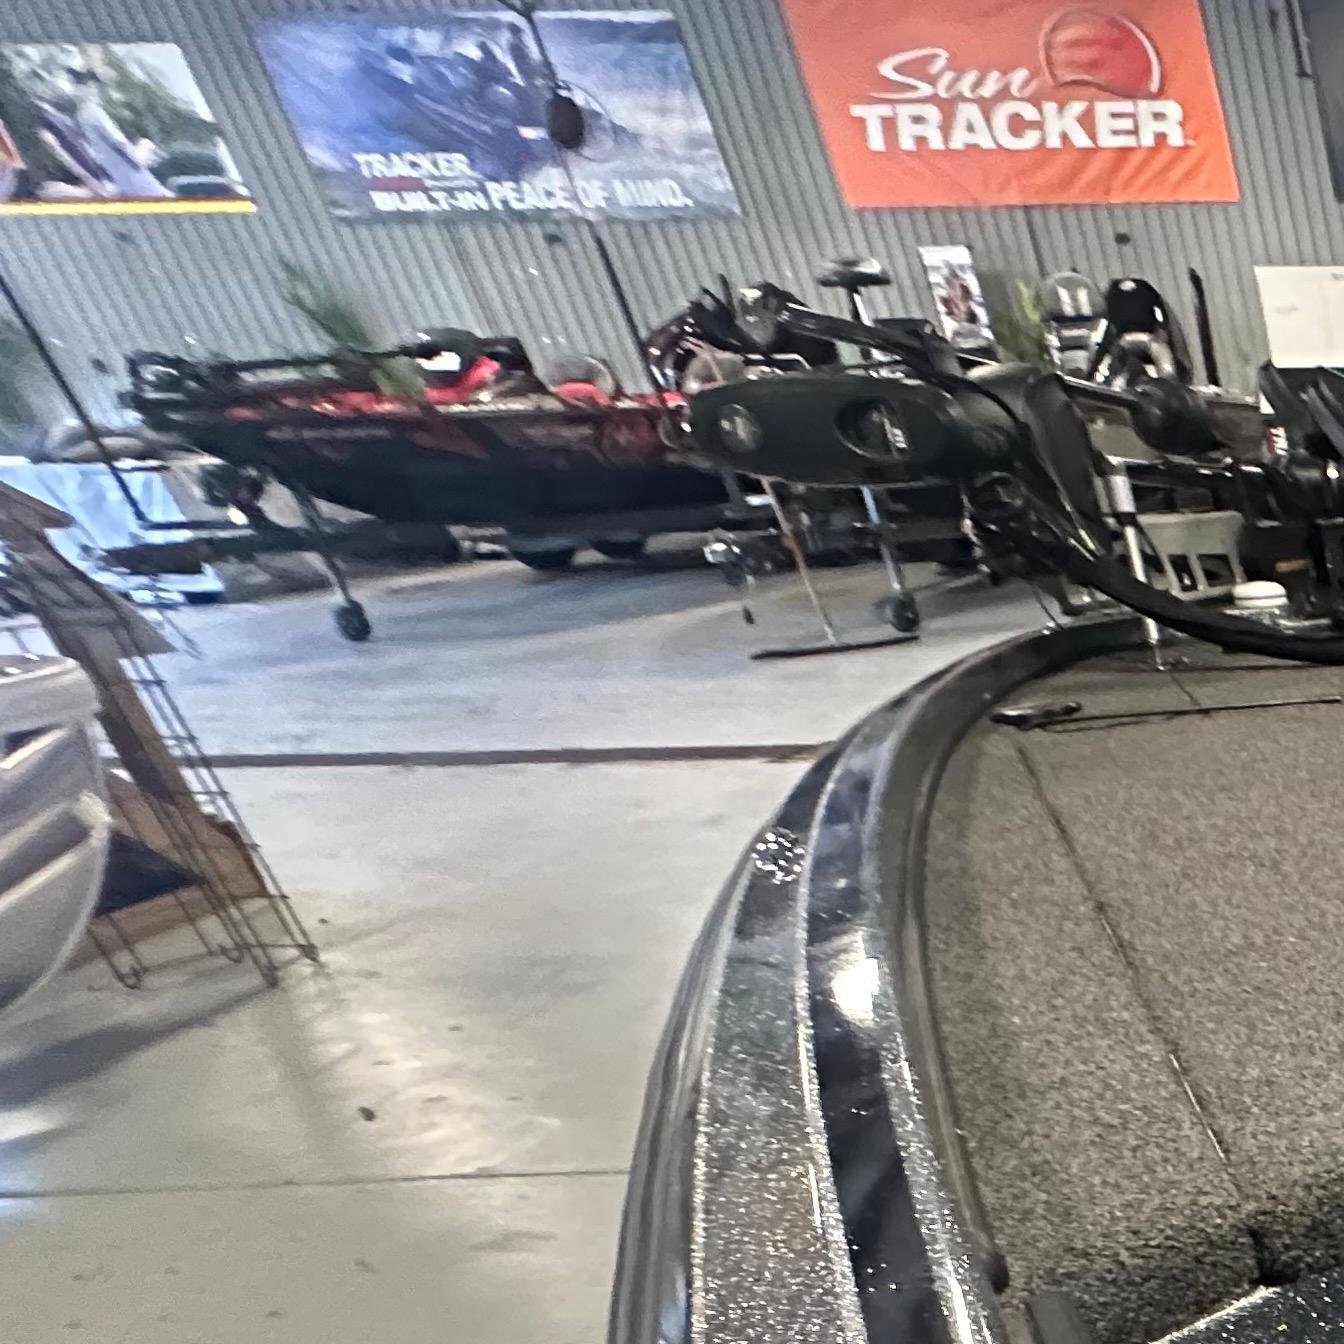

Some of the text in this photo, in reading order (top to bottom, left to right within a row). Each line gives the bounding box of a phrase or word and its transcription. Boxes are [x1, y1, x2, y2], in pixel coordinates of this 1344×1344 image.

[867, 47, 1040, 99] Sun
[849, 100, 1185, 152] TRACKER
[351, 151, 484, 179] TRACKER
[368, 189, 489, 212] BUILT-IN
[484, 181, 578, 211] PEACE
[574, 180, 609, 209] OF
